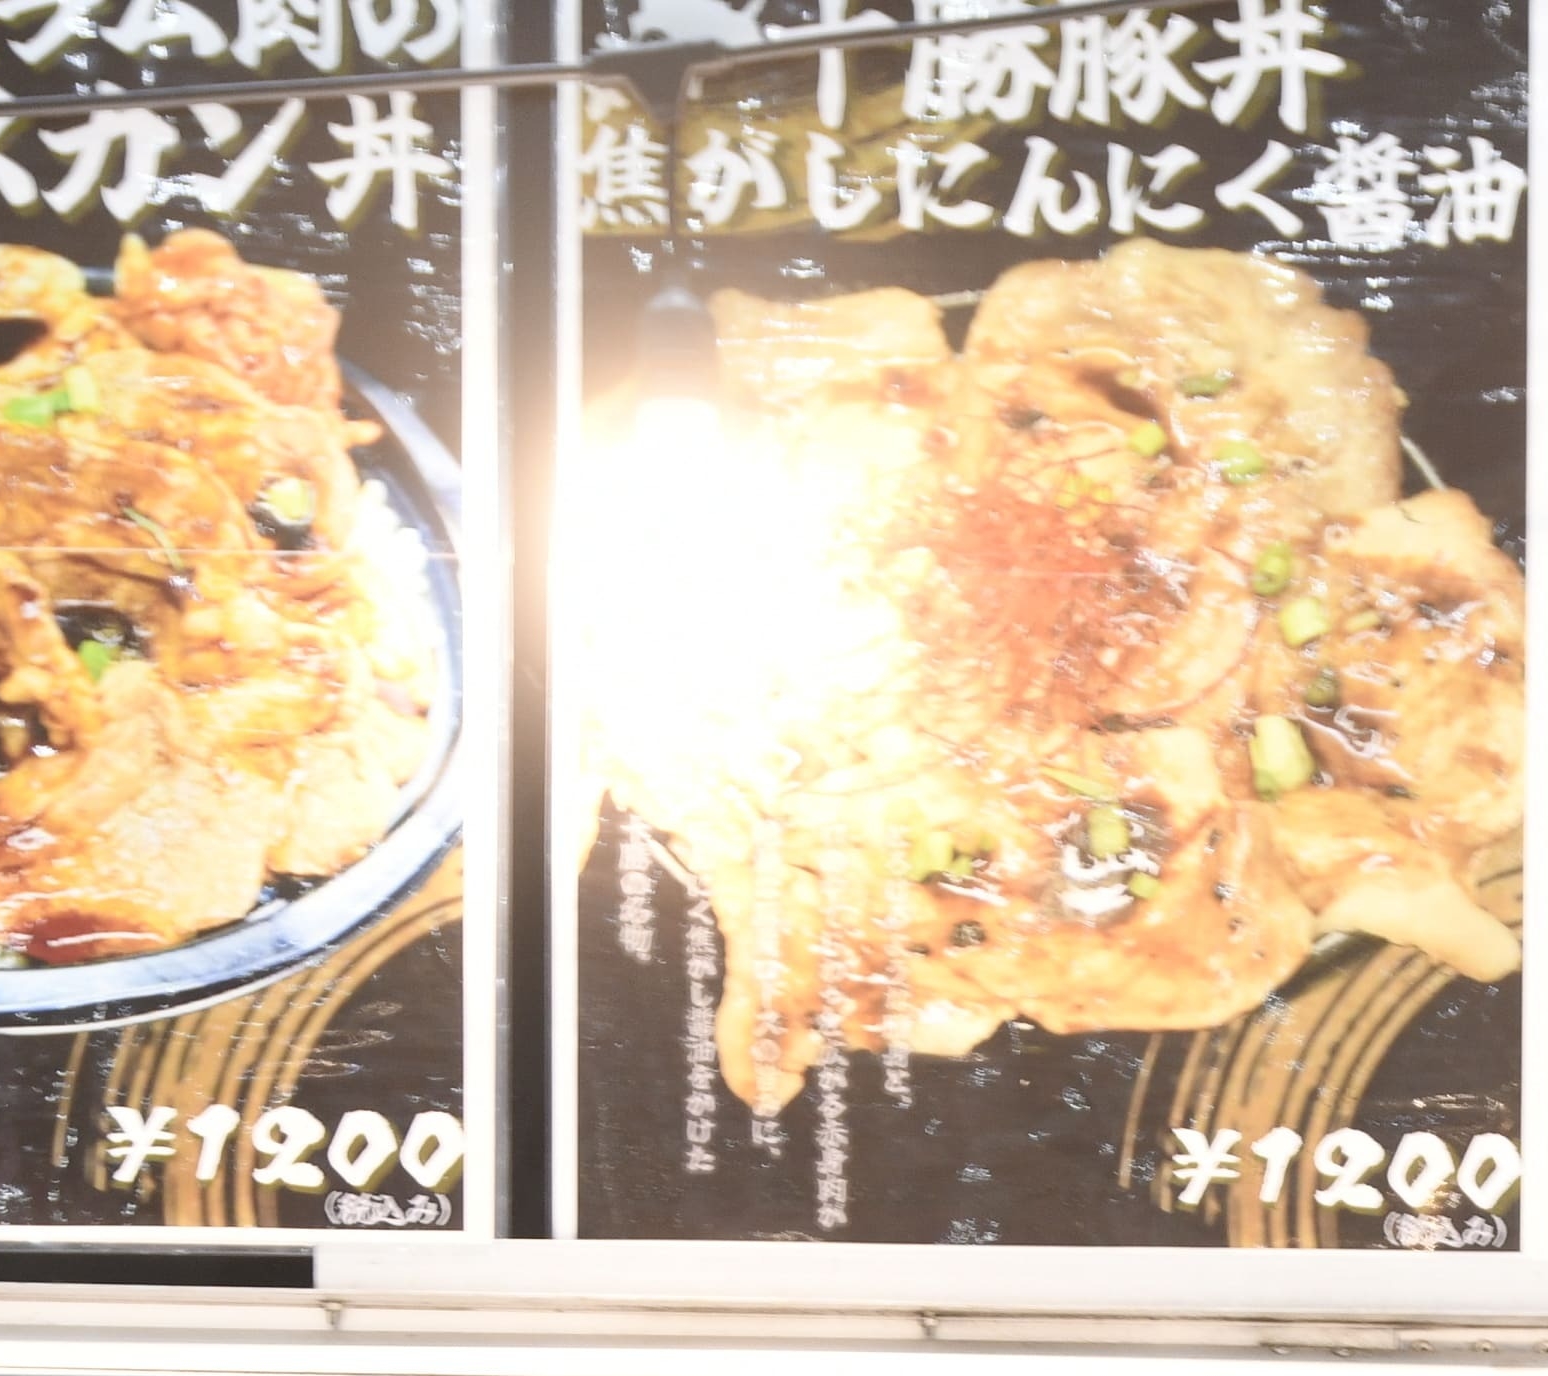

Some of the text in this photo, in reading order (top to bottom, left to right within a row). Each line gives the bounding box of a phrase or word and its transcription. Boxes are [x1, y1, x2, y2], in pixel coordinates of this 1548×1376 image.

[574, 124, 1527, 248] 焦がしにんにく醤油
[105, 1105, 465, 1190] ¥1200
[1172, 1127, 1523, 1214] ¥1200
